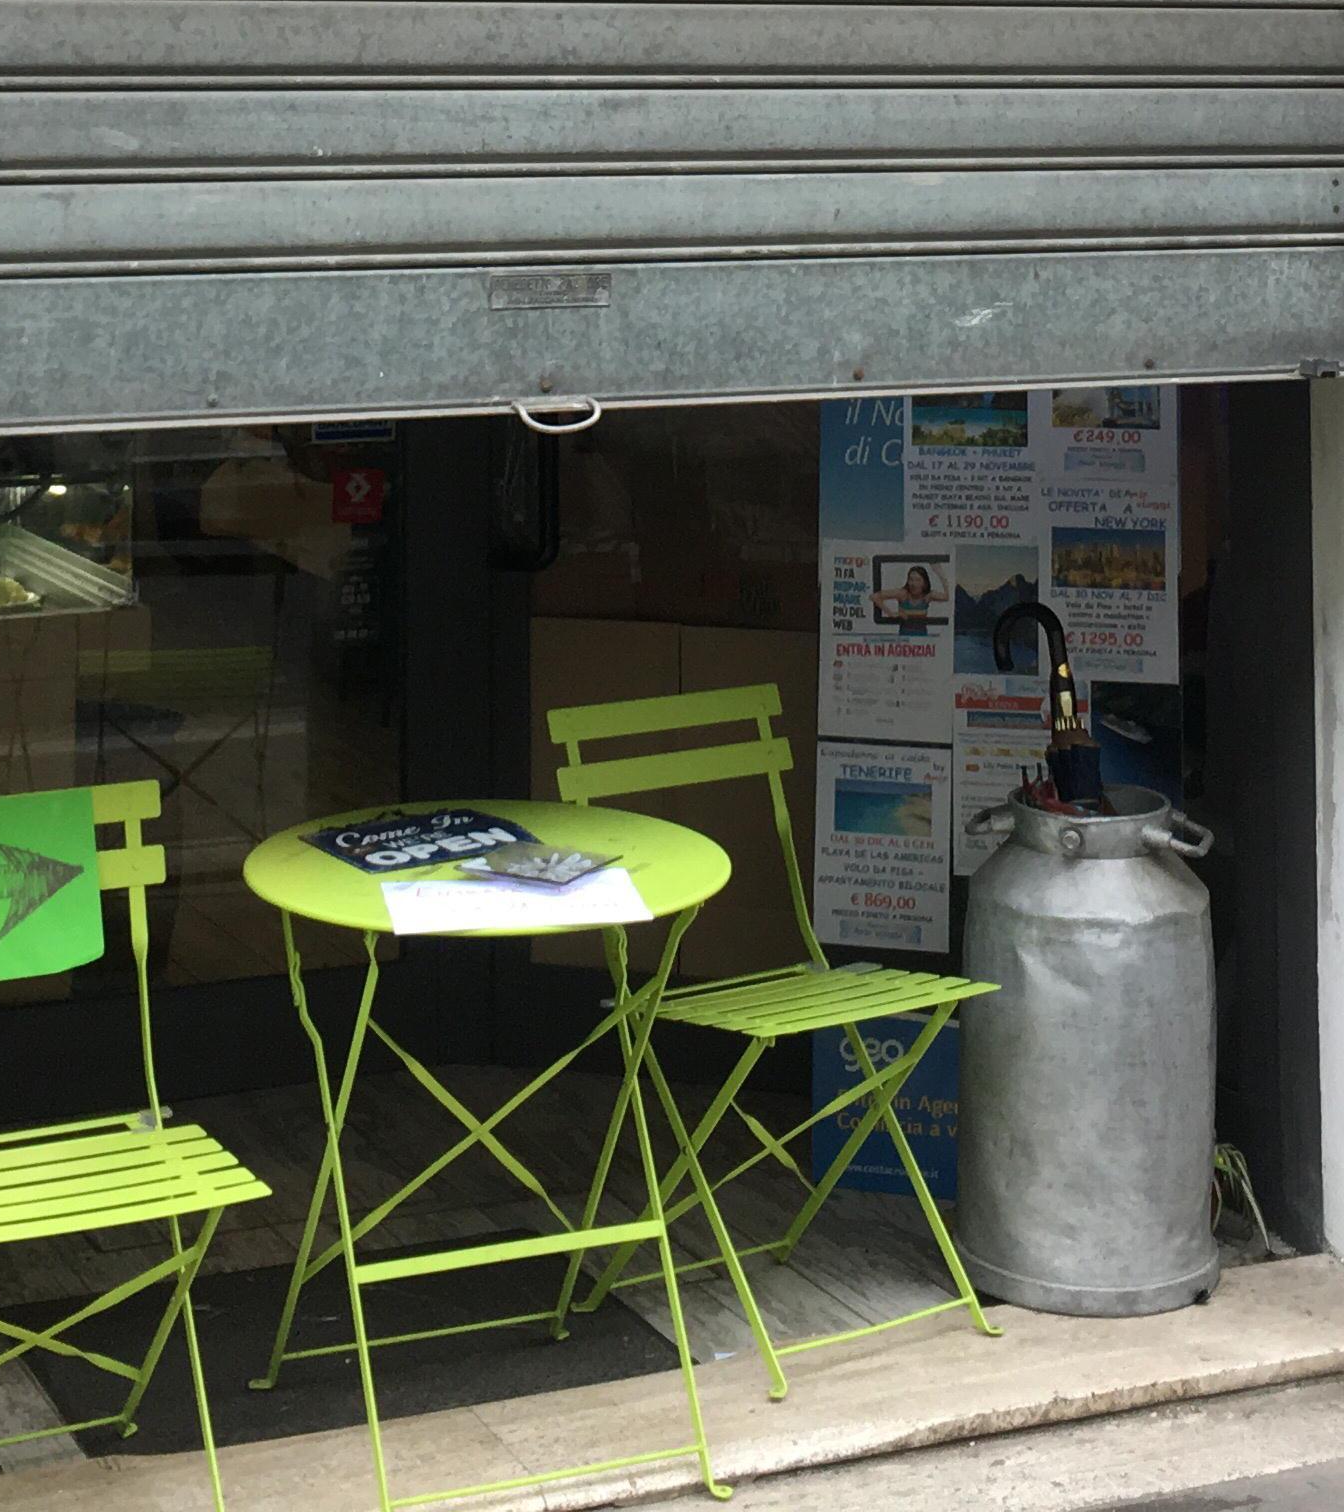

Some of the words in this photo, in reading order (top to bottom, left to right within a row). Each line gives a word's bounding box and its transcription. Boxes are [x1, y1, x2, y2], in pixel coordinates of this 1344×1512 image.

[844, 436, 870, 466] di
[881, 438, 904, 467] C
[907, 461, 928, 470] DAL
[931, 461, 943, 470] 17
[947, 462, 960, 471] AL
[963, 462, 976, 471] 29
[980, 462, 1036, 472] NOVEMBRE
[1048, 500, 1107, 513] OFFERTA
[1123, 503, 1133, 514] A
[928, 514, 939, 528] €
[1094, 516, 1129, 528] NEW
[1131, 517, 1167, 529] YORK
[849, 606, 866, 618] DEL
[832, 618, 853, 631] WEB
[836, 643, 871, 657] ENTRA
[874, 643, 885, 657] IN
[335, 825, 421, 848] Come
[430, 814, 474, 831] In
[364, 826, 518, 866] OPEN
[850, 892, 860, 906] €
